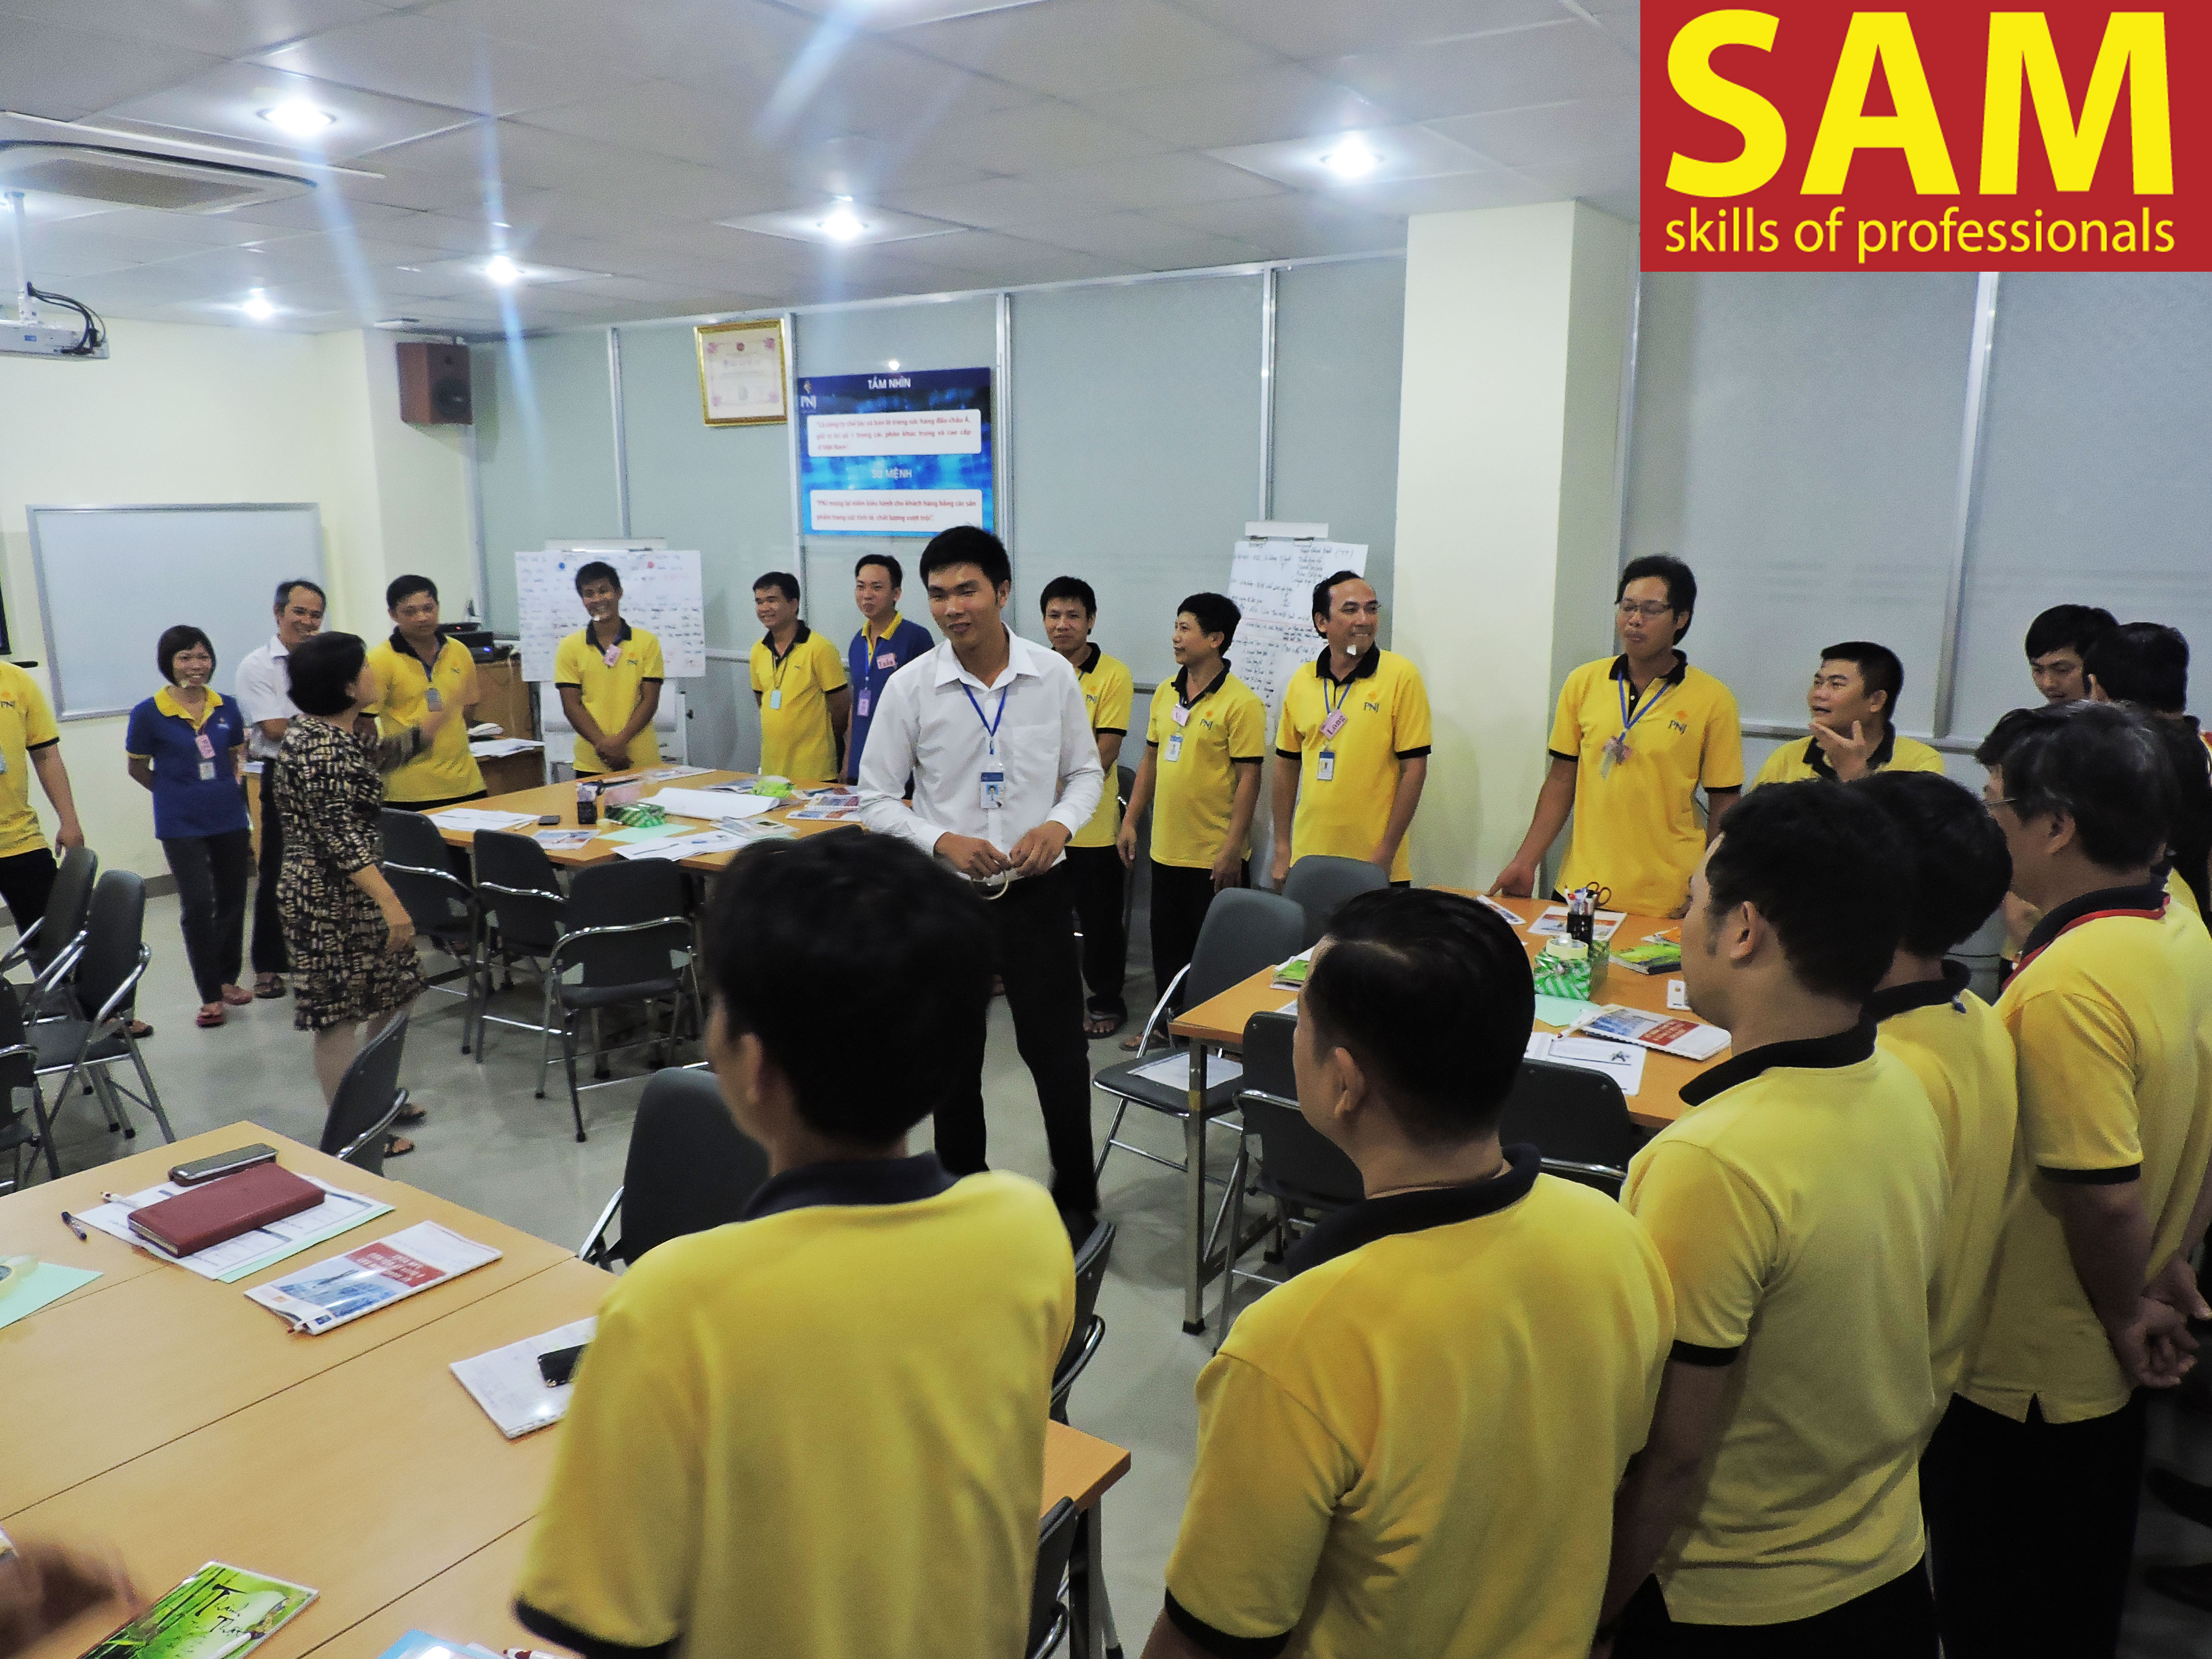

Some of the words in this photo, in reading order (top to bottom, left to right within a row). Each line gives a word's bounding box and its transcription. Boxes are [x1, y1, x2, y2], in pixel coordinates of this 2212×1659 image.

[1364, 702, 1380, 713] PNJ
[1200, 719, 1214, 730] PNJ
[1668, 720, 1687, 735] PNJ
